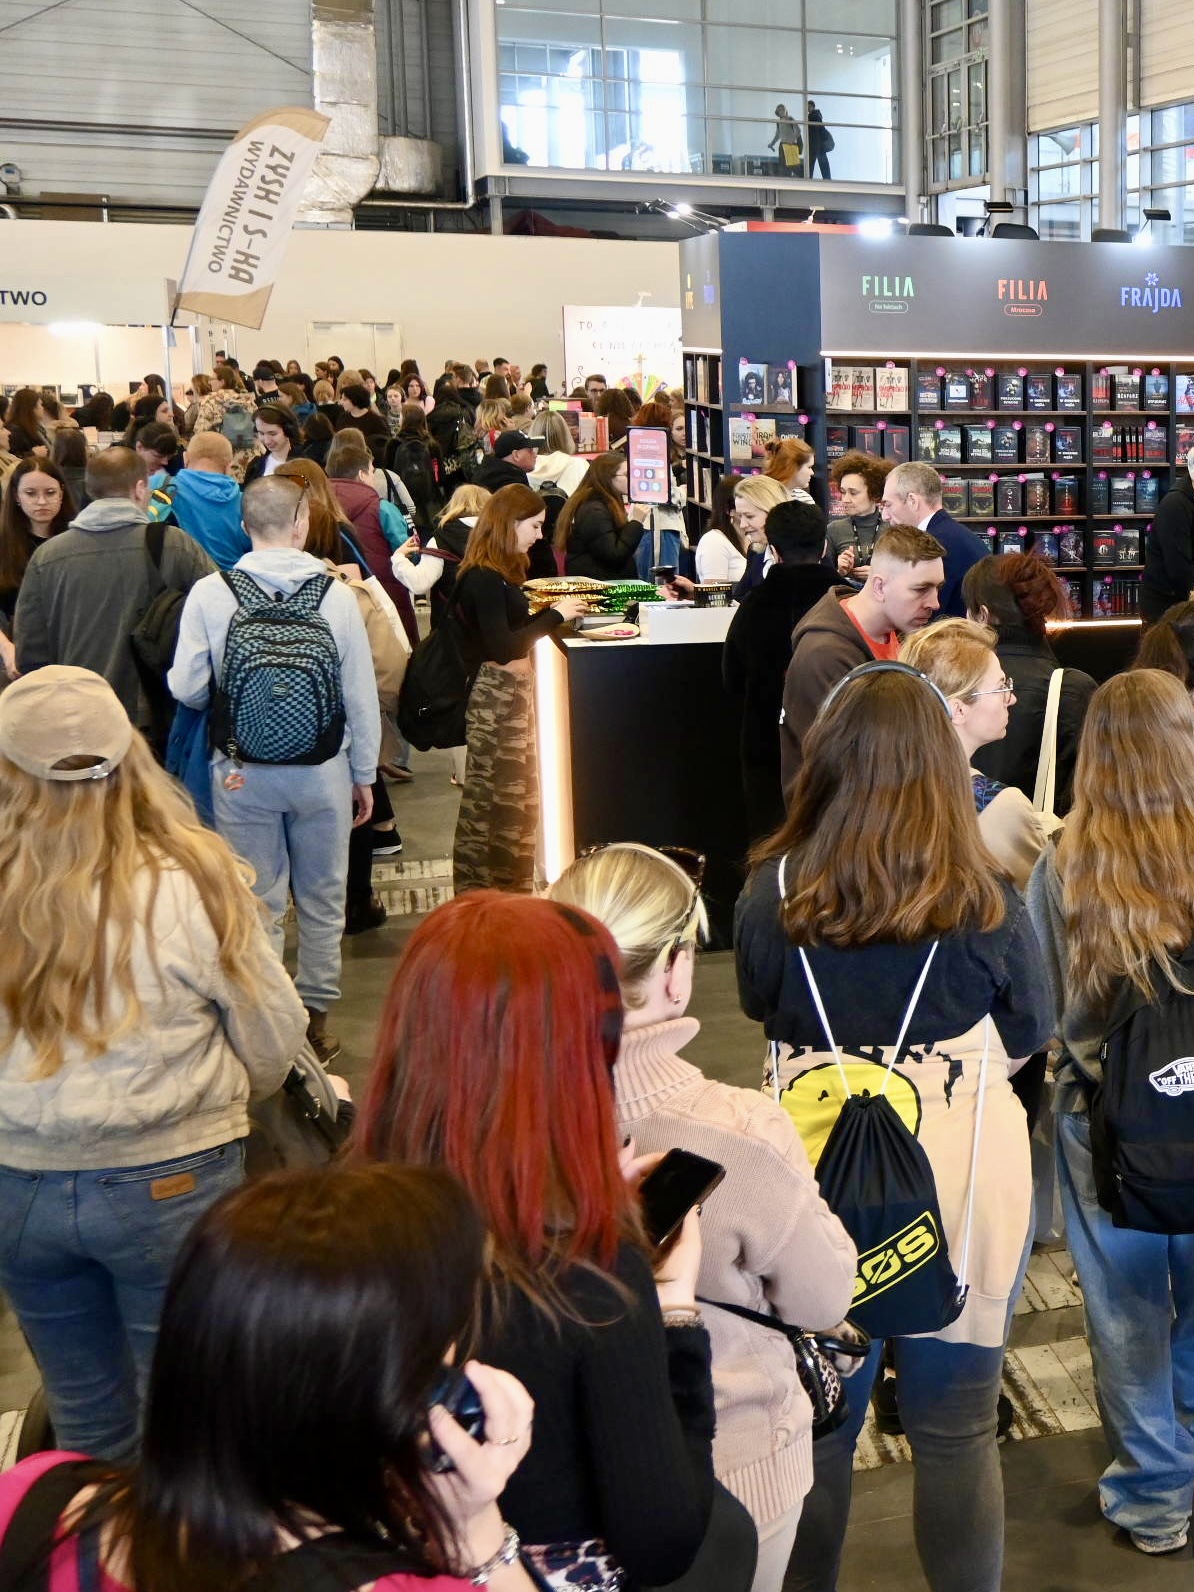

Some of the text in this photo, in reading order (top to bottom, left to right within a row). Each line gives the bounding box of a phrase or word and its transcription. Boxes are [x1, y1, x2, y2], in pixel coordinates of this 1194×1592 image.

[208, 140, 264, 273] WYDAWNICTWO
[862, 275, 914, 297] FILIA
[998, 279, 1048, 301] FILIA
[1120, 286, 1182, 313] FRAJDA
